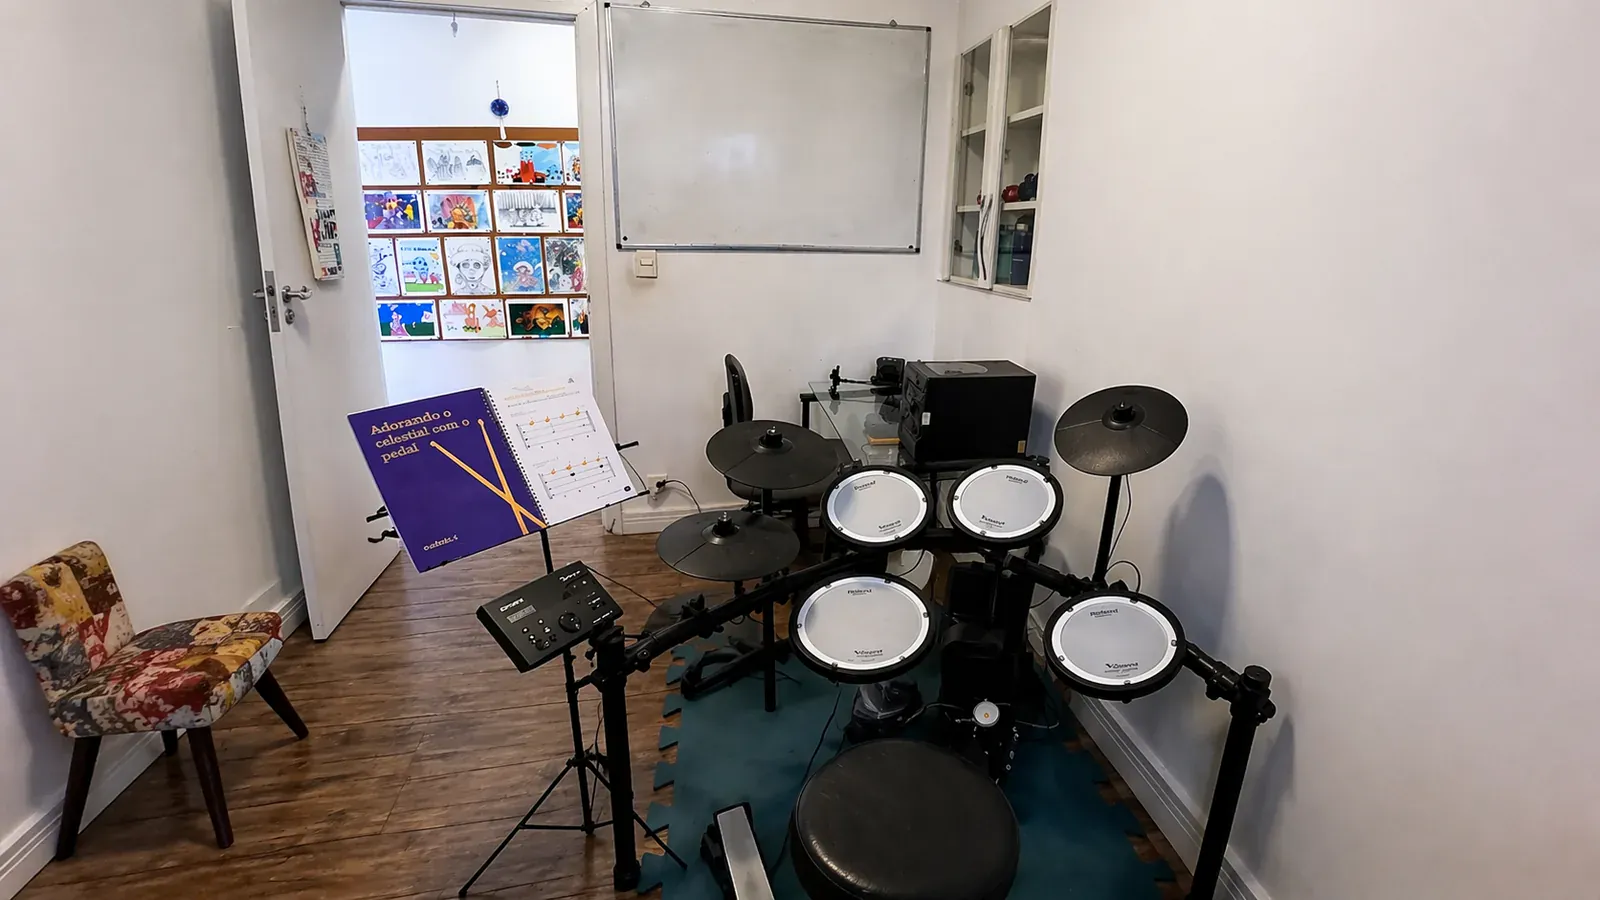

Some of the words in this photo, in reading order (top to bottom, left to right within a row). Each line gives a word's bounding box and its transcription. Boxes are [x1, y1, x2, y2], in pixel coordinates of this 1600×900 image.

[371, 412, 440, 435] Adorando
[376, 427, 430, 448] celestial
[432, 421, 460, 434] com
[381, 443, 419, 463] pedal
